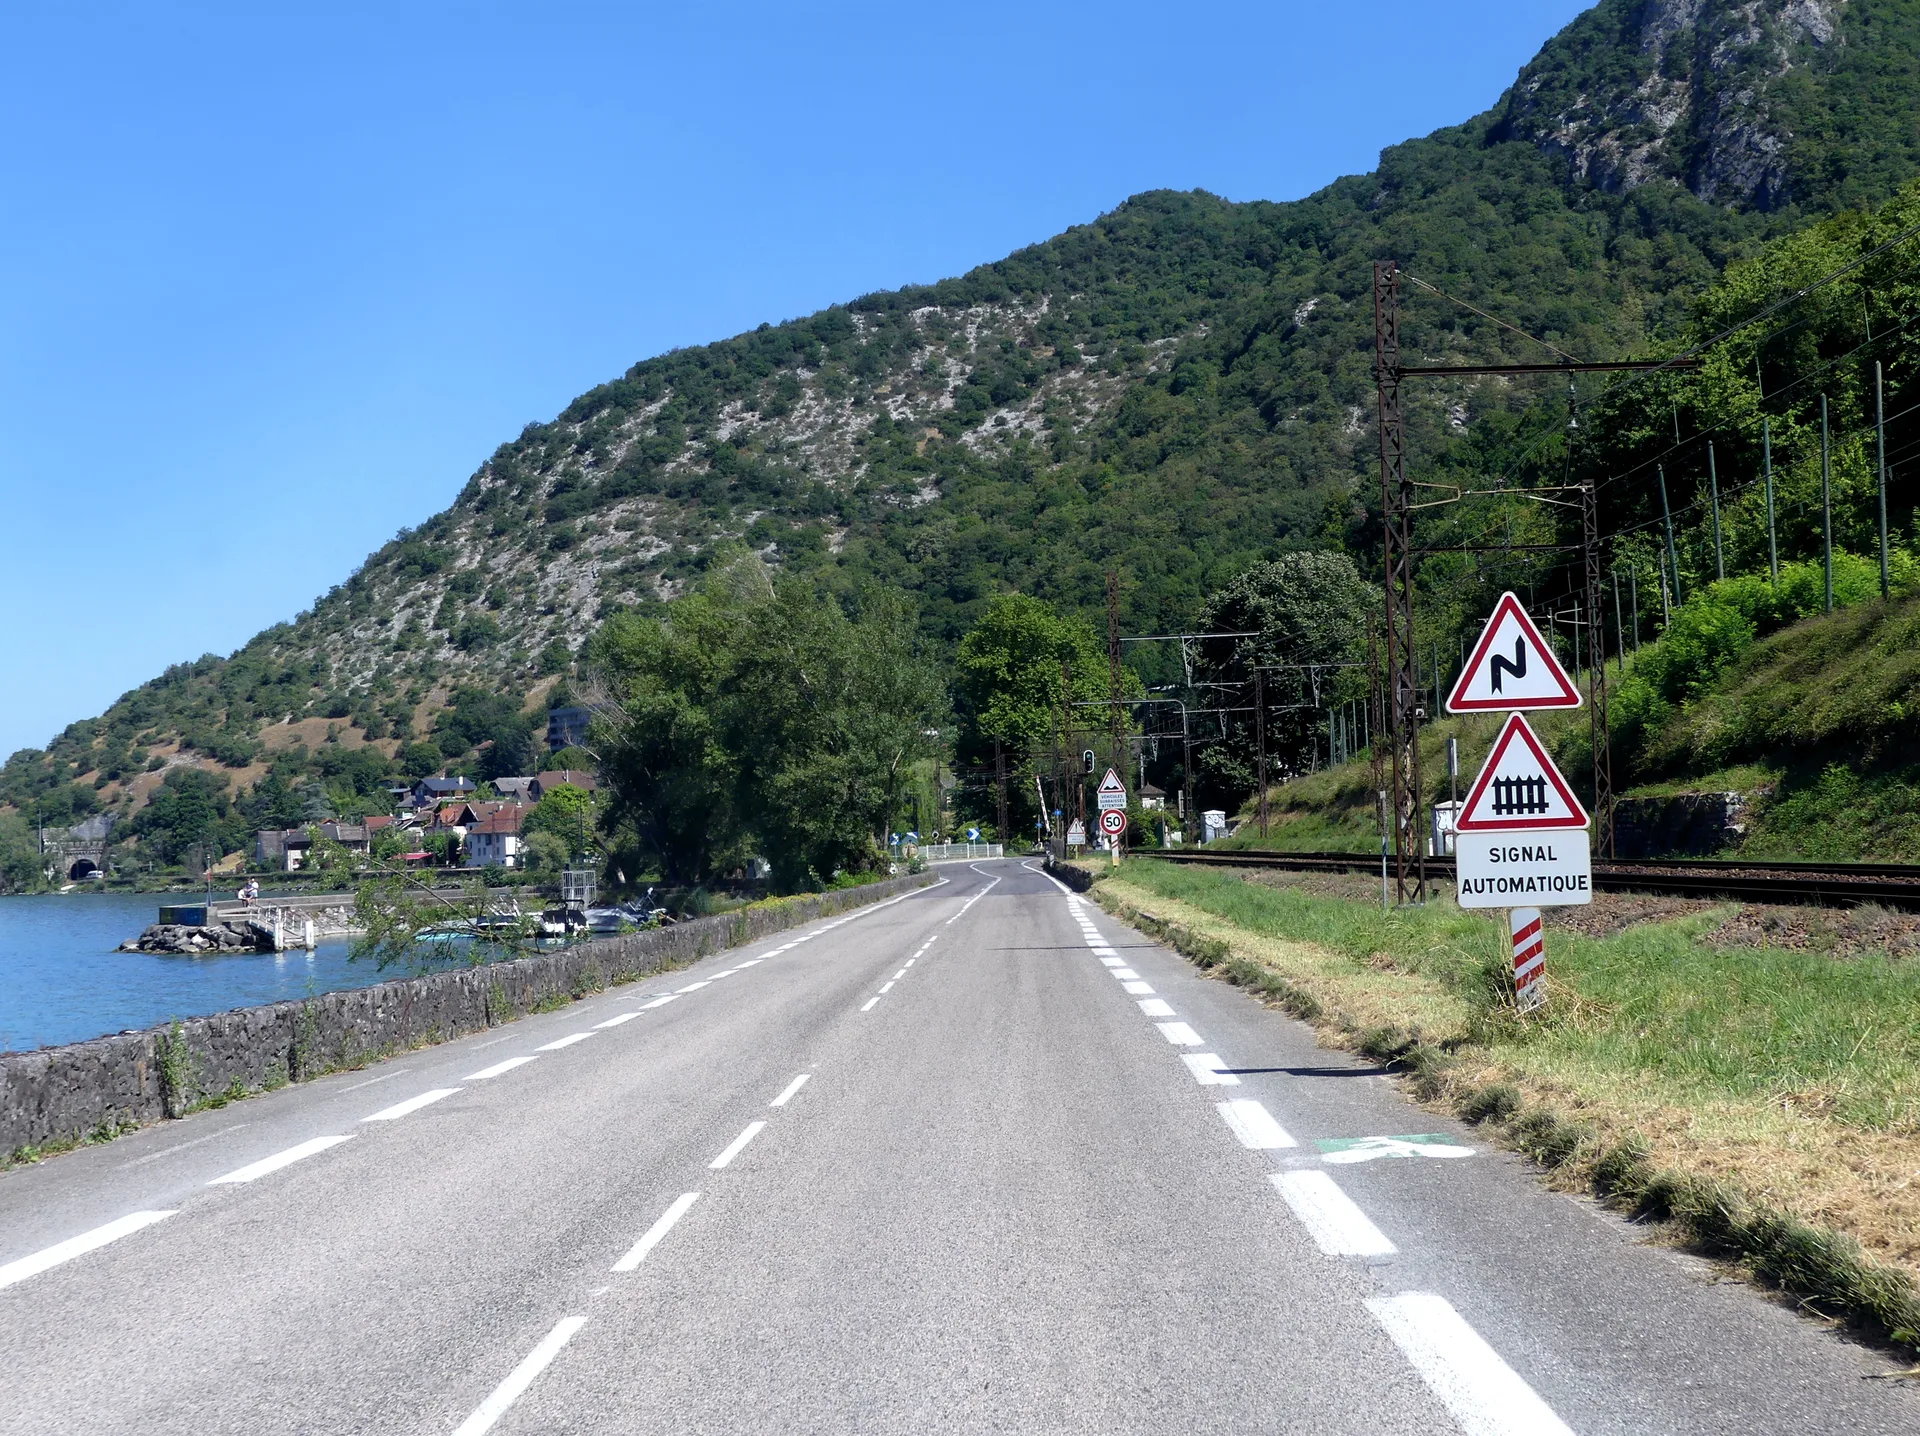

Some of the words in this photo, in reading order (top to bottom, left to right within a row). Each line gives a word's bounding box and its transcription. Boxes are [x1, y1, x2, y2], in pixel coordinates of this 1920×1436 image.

[1106, 816, 1121, 827] 50
[1489, 845, 1558, 863] SIGNAL
[1461, 875, 1588, 894] AUTOMATIQUE
